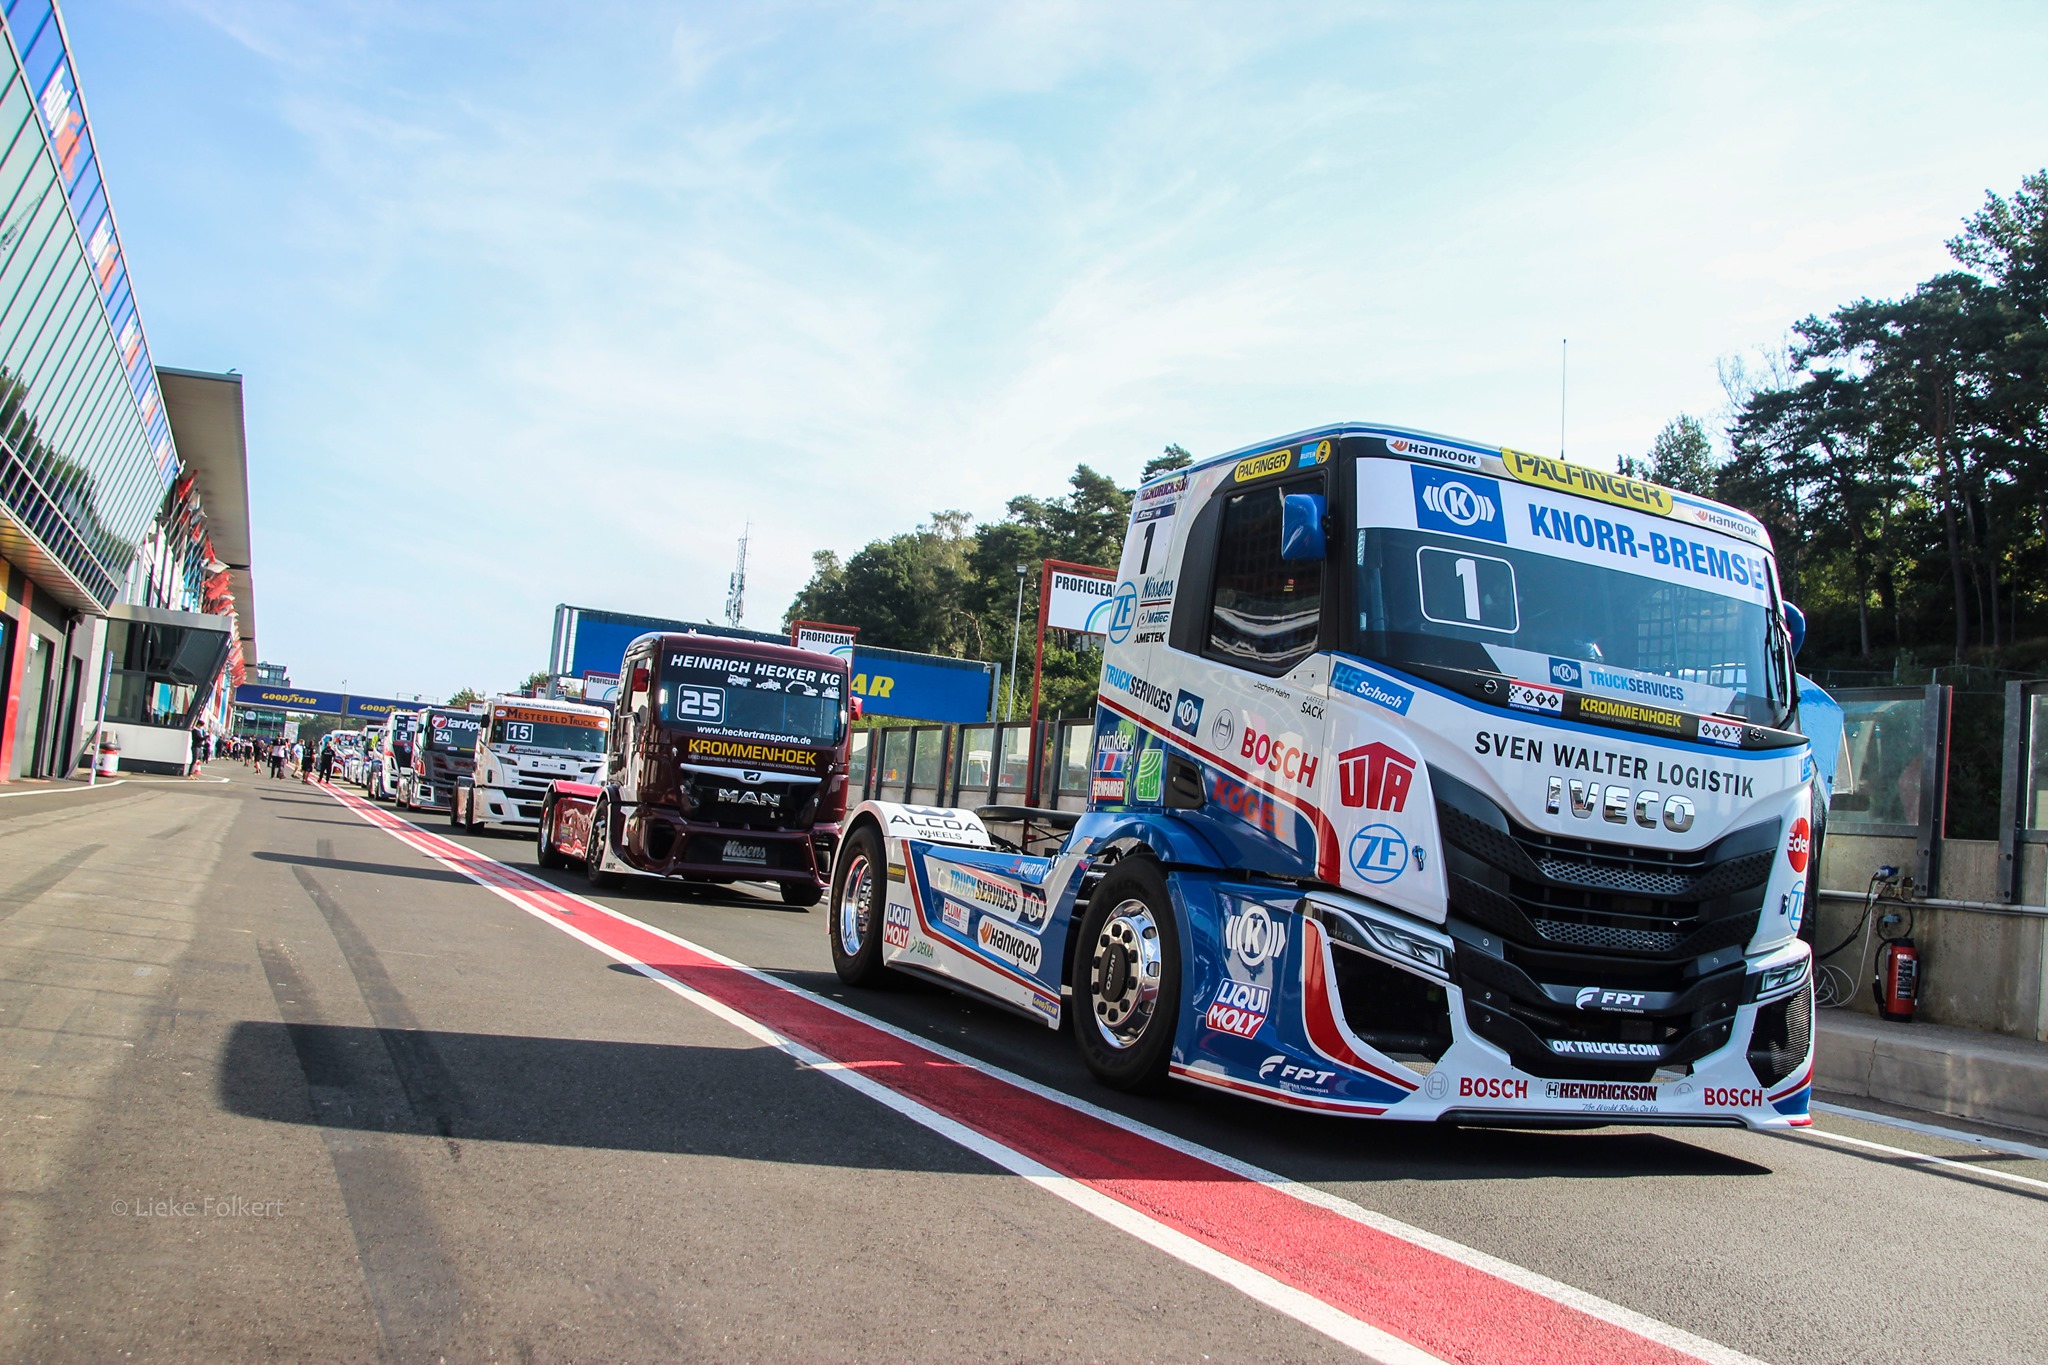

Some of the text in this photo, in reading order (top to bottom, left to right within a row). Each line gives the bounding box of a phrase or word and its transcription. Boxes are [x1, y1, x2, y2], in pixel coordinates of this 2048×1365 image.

[1237, 453, 1288, 478] PALFINGER
[1141, 477, 1191, 500] HENDRICKSON
[1511, 449, 1664, 509] PALFINGER
[1140, 522, 1156, 574] 1
[1529, 503, 1765, 591] KNORR-BREMSE
[1142, 576, 1174, 599] Nissens
[1456, 558, 1481, 621] 1
[1109, 590, 1137, 635] ZF
[1134, 632, 1166, 643] AMETEK
[670, 654, 841, 686] HEINRICH HECKER KG
[1105, 664, 1173, 714] TRUCKSERVICES
[1254, 681, 1291, 700] Jochen Hahn
[1589, 669, 1685, 701] TRUCKSERVICES
[262, 693, 317, 705] GOODYEAR
[681, 690, 721, 717] 25
[1300, 701, 1325, 720] SACK
[1581, 697, 1682, 727] KROMMENHOEK
[435, 731, 450, 741] 24
[510, 724, 529, 740] 15
[697, 726, 812, 745] www.heckertransporte.de
[1099, 731, 1132, 750] winkler
[688, 739, 817, 765] KROMMENHOEK
[1241, 726, 1319, 788] BOSCH
[1474, 731, 1754, 798] SVEN WALTER LOGISTIK
[1339, 741, 1416, 812] UTA
[718, 788, 781, 807] MAN
[1092, 780, 1124, 797] FERNFAHRER
[1545, 776, 1696, 833] IVECO
[890, 815, 984, 833] ALCOA
[917, 829, 962, 840] WHEELS
[723, 840, 766, 859] Nissens
[1354, 831, 1407, 880] ZF
[950, 869, 1019, 913] TRUCKSERVICES
[888, 904, 910, 928] LIQUI
[945, 901, 961, 920] PLUIM
[885, 924, 909, 947] MOLY
[917, 941, 934, 958] DEKRA
[1105, 953, 1116, 990] IVECO
[1217, 982, 1268, 1013] LIQUI
[1601, 992, 1645, 1006] FPT
[1209, 1004, 1264, 1035] MOLY
[1280, 1064, 1336, 1084] FPT
[1459, 1077, 1528, 1099] BOSCH
[1559, 1082, 1658, 1101] HENDRICKSON
[1704, 1087, 1763, 1106] BOSCH
[1582, 1103, 1595, 1111] The
[1620, 1104, 1638, 1112] Rides
